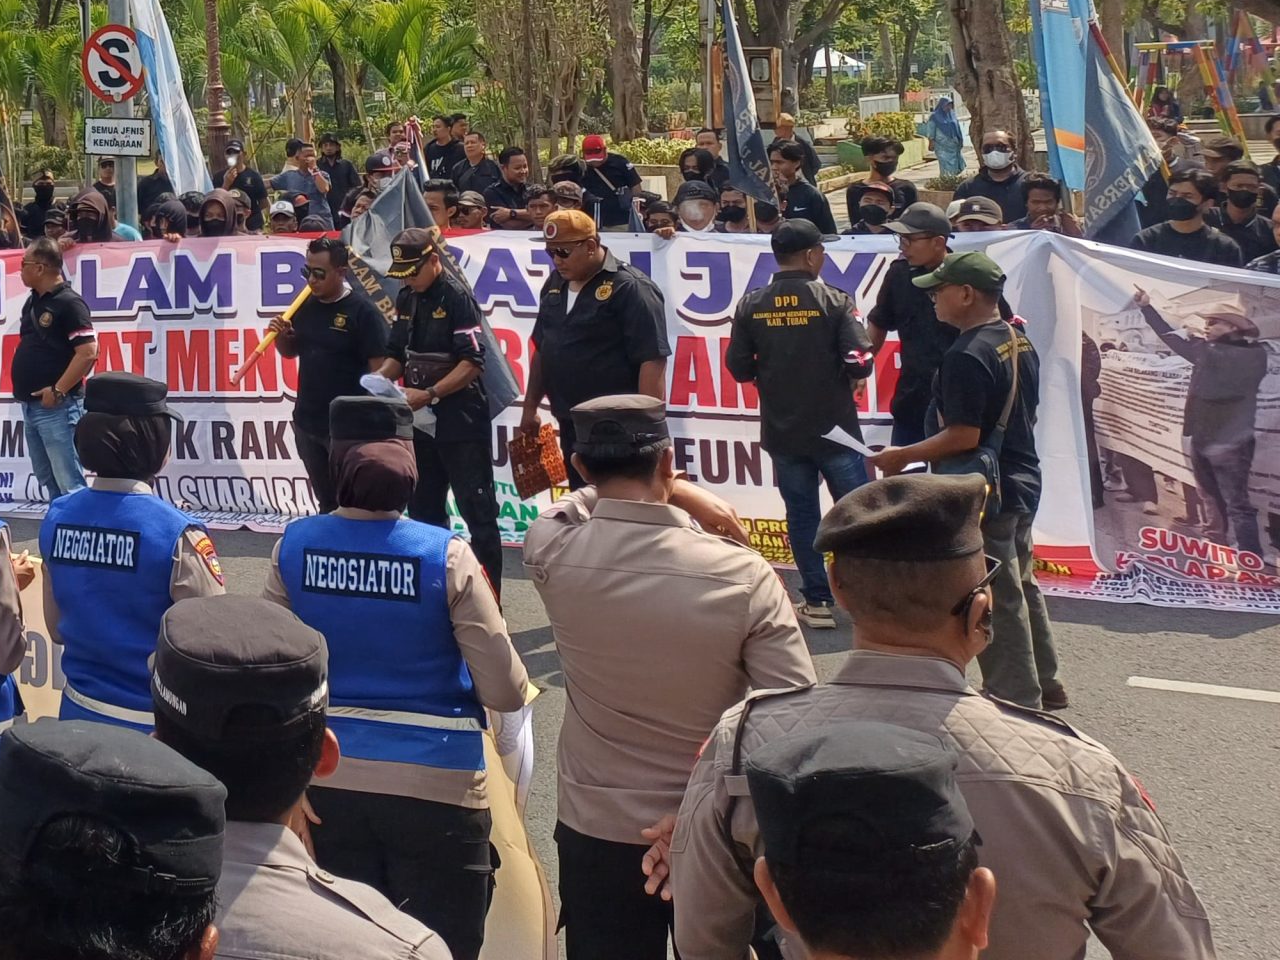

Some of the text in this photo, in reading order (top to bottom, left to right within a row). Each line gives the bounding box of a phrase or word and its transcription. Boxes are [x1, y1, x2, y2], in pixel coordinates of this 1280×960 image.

[91, 125, 145, 136] SEMUA JENIS
[93, 138, 143, 149] KENDARAAN
[65, 251, 235, 313] LAM
[775, 295, 799, 307] DPD
[1139, 526, 1265, 572] SUWITO
[305, 554, 416, 597] NEGOSIATOR
[1237, 570, 1280, 587] AK
